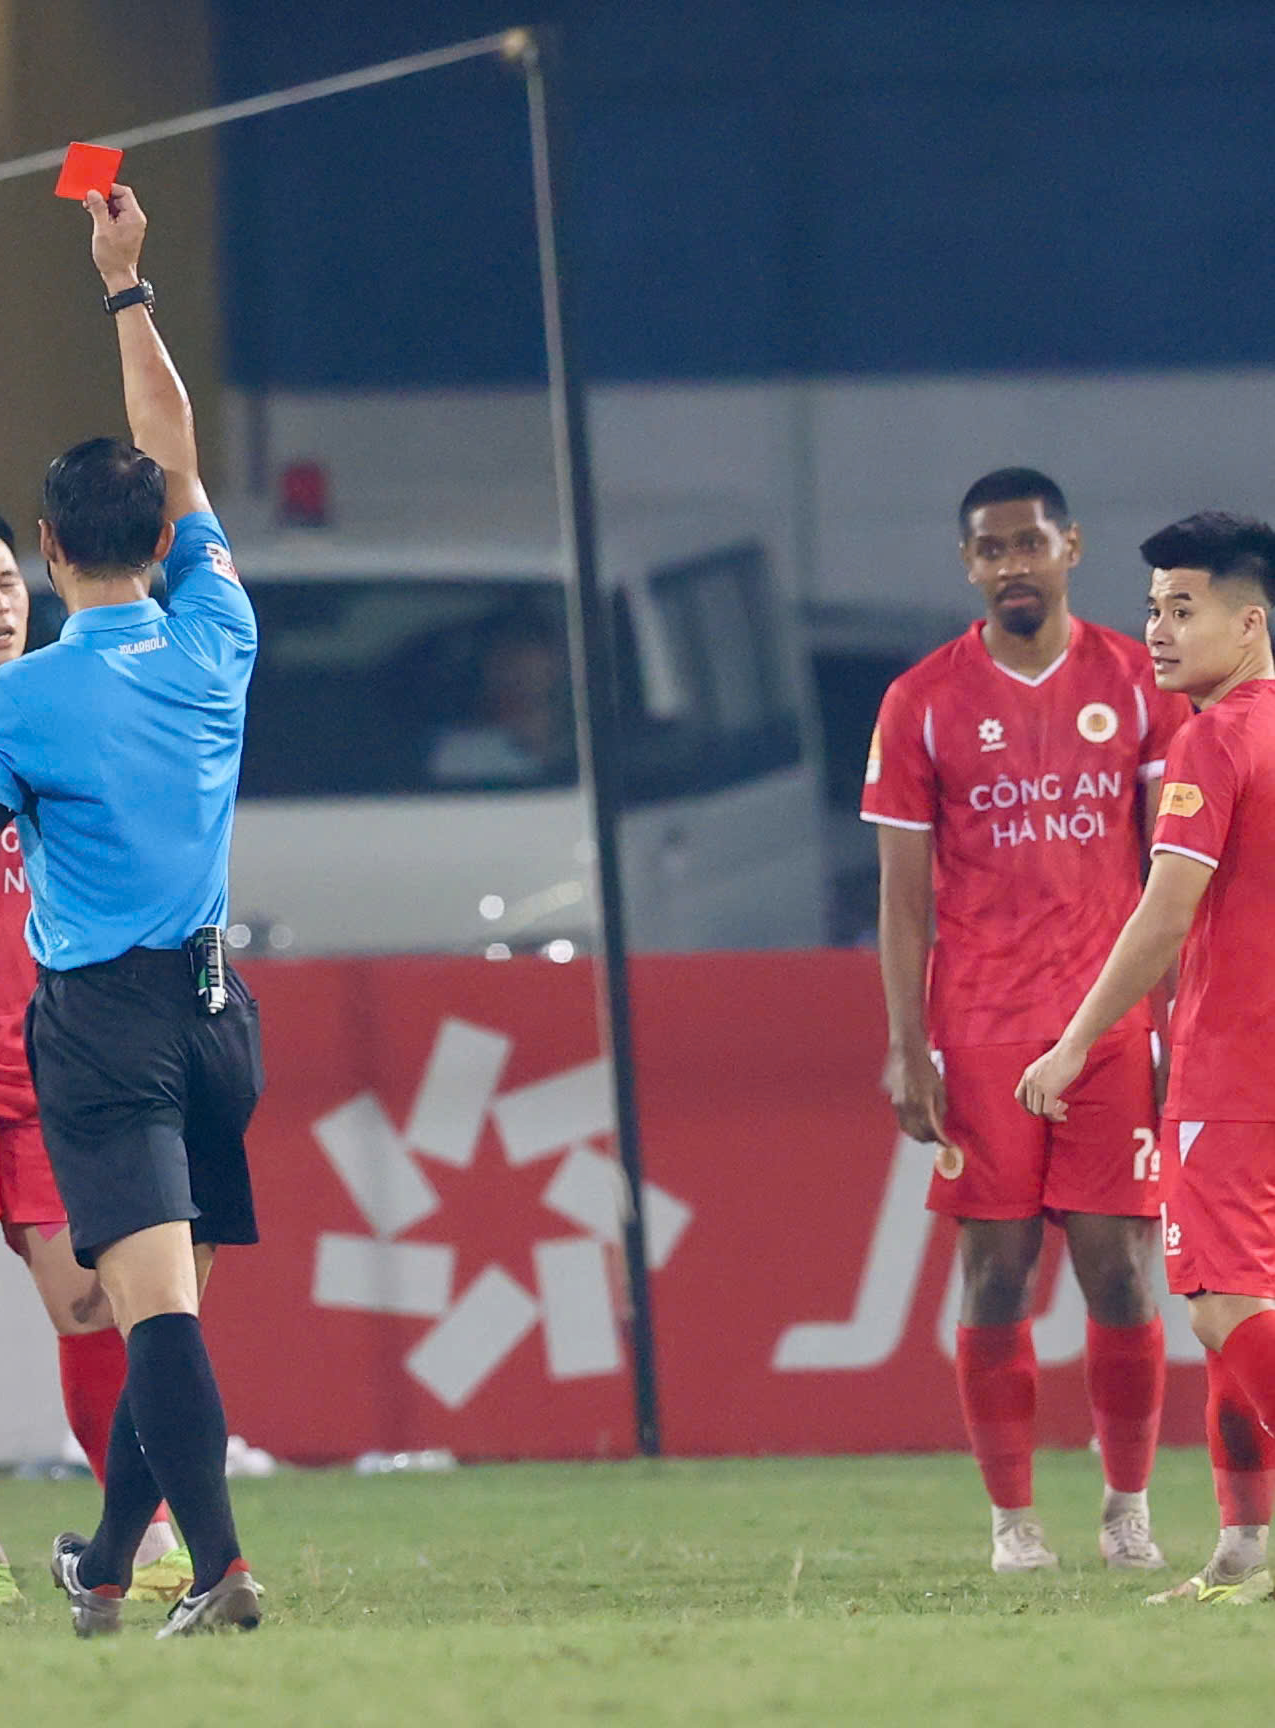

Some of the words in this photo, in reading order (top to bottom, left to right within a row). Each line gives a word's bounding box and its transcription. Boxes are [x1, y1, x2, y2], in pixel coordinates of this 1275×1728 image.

[969, 772, 1062, 811] CÔNG
[1074, 771, 1122, 799] AN
[991, 811, 1037, 848] HÀ
[1044, 804, 1105, 846] NỘI
